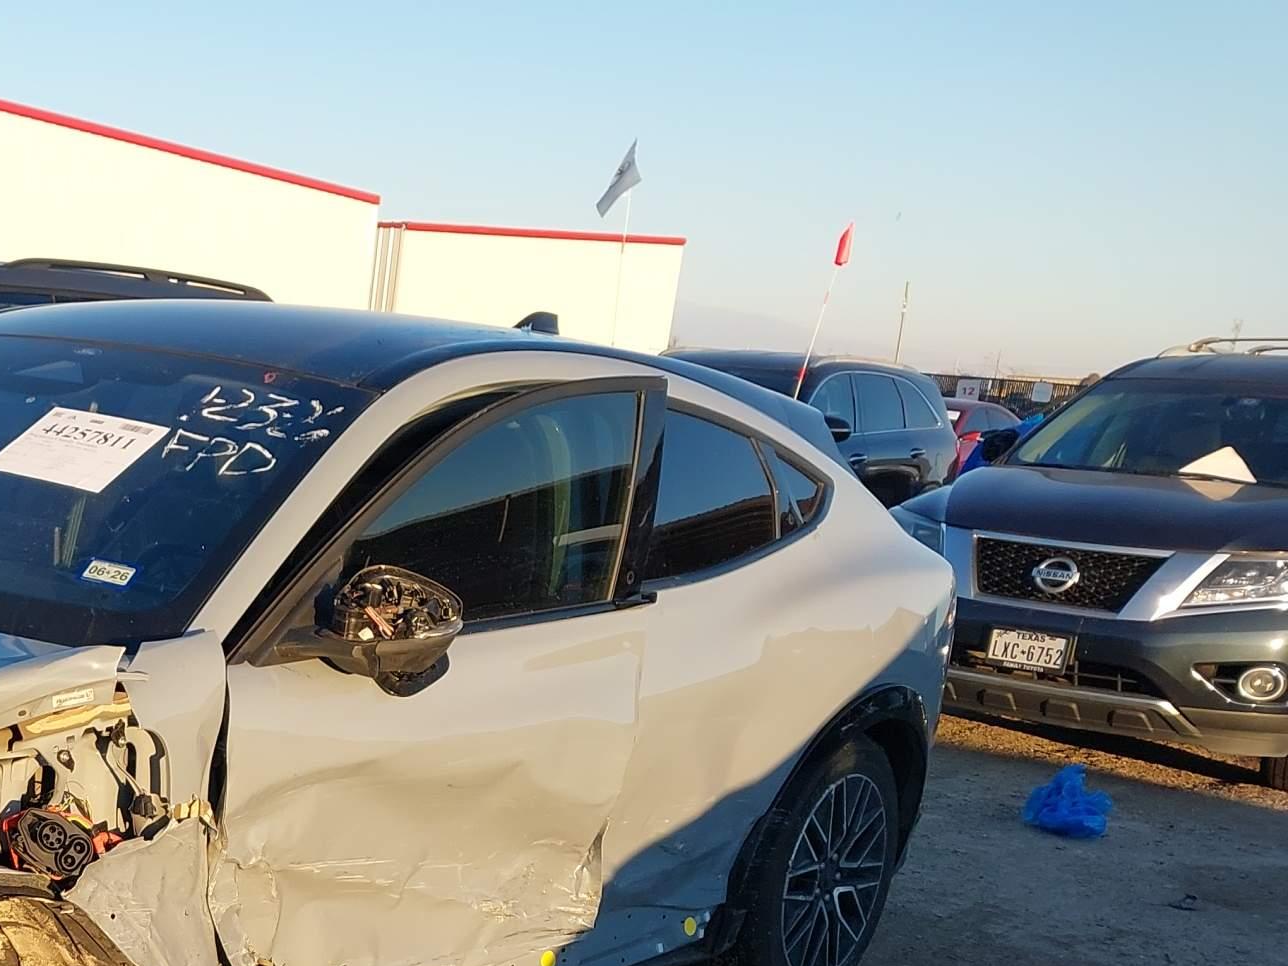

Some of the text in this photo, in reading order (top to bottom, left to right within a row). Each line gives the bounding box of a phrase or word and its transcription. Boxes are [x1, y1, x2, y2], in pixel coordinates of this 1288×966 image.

[962, 386, 976, 396] 12
[41, 422, 137, 451] 44257811
[161, 428, 277, 476] FPD
[88, 565, 130, 581] 06 26
[1036, 570, 1073, 580] NISSAN
[1015, 632, 1047, 643] TEXAS
